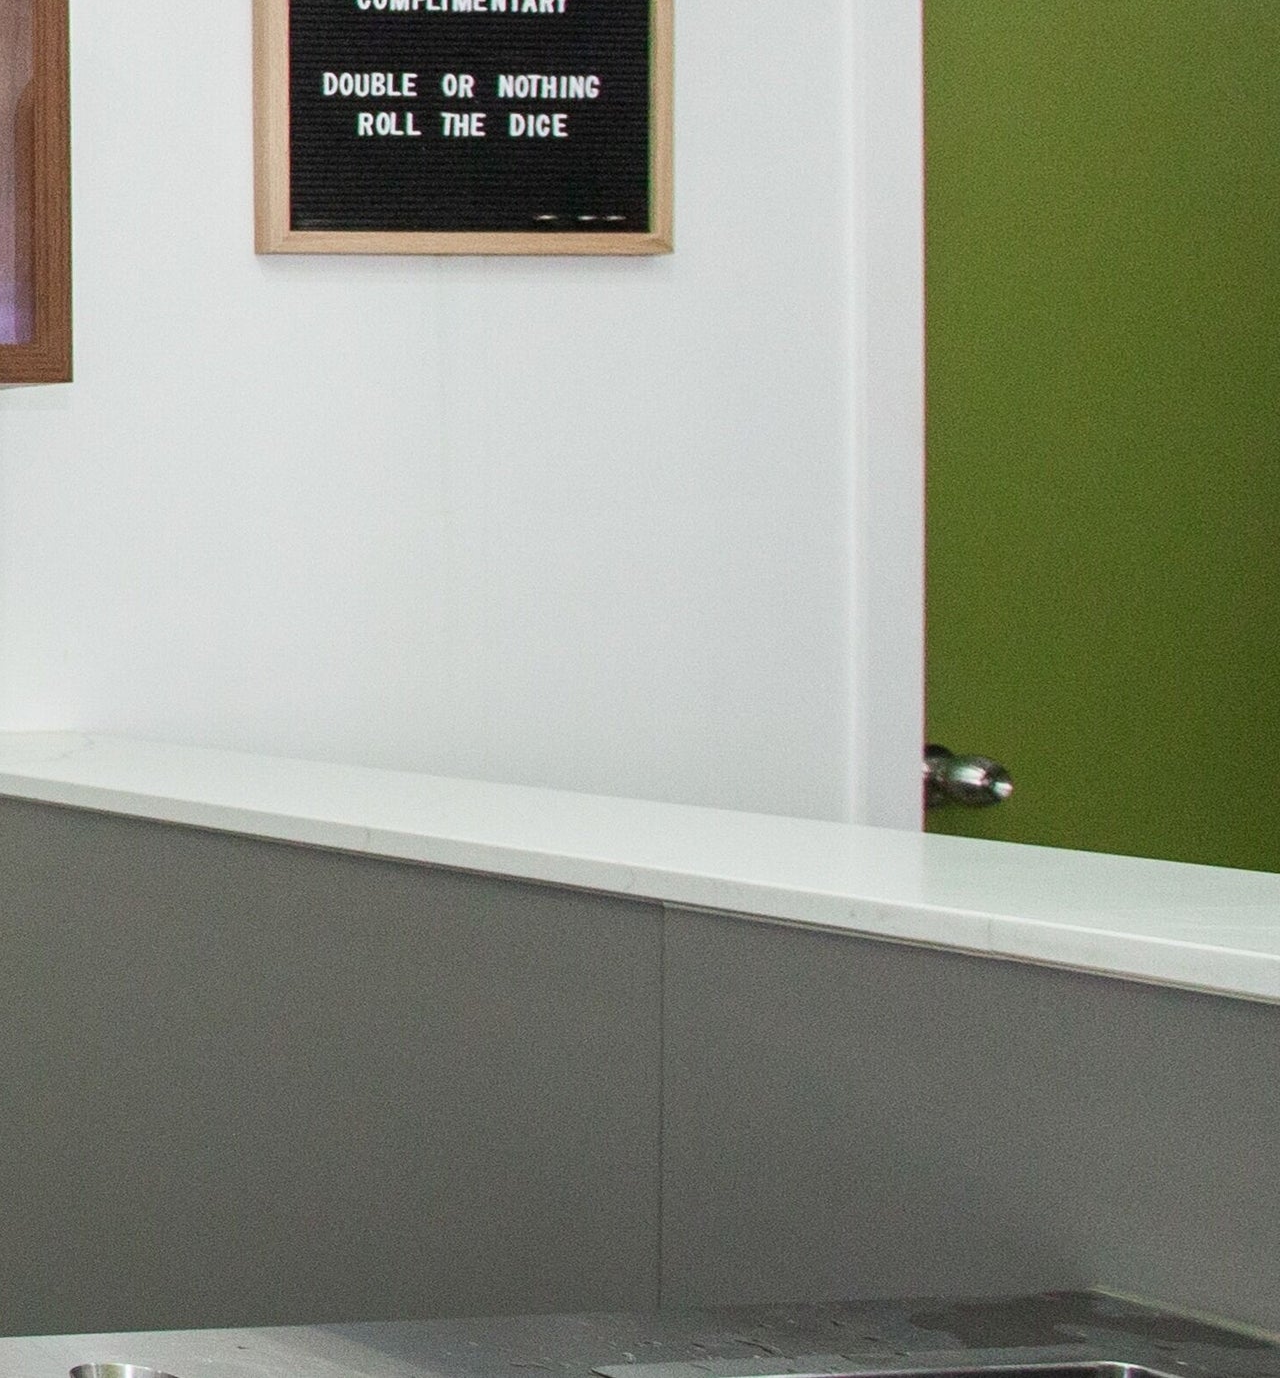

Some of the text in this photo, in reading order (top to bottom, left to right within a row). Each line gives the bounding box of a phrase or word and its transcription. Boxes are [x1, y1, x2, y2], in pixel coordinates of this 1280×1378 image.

[321, 71, 601, 100] DOUBLE OR NOTHING
[357, 112, 569, 138] ROLL THE DICE
